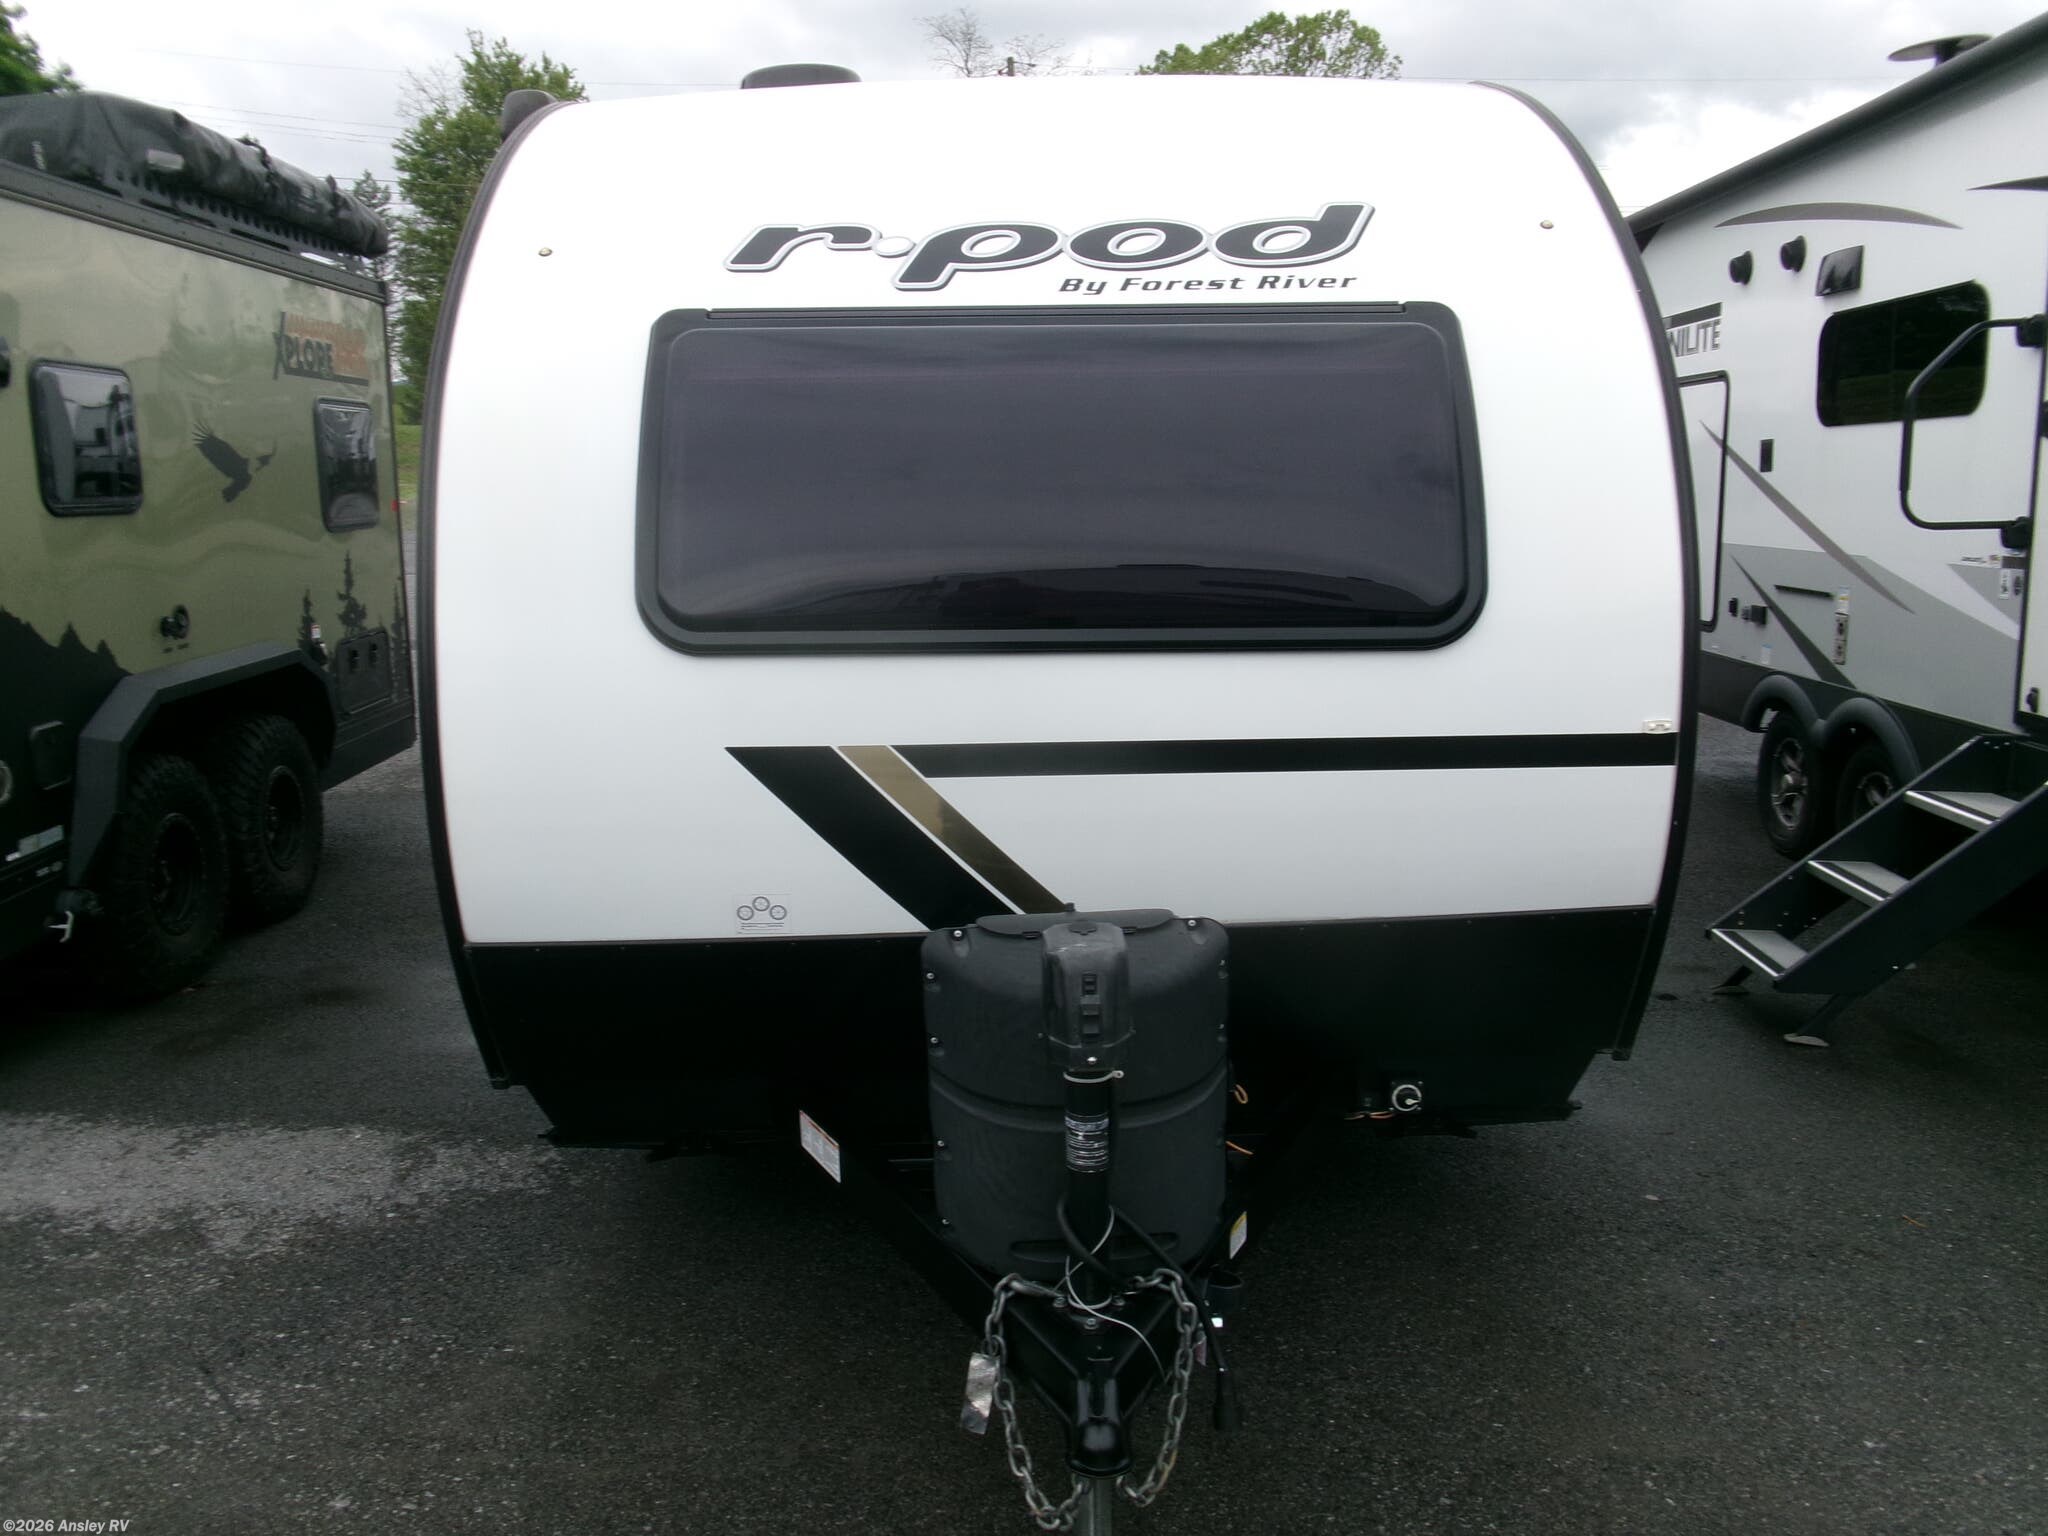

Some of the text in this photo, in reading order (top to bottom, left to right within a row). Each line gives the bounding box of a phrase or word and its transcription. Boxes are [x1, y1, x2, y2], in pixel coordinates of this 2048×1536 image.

[1058, 274, 1357, 295] By Forest River
